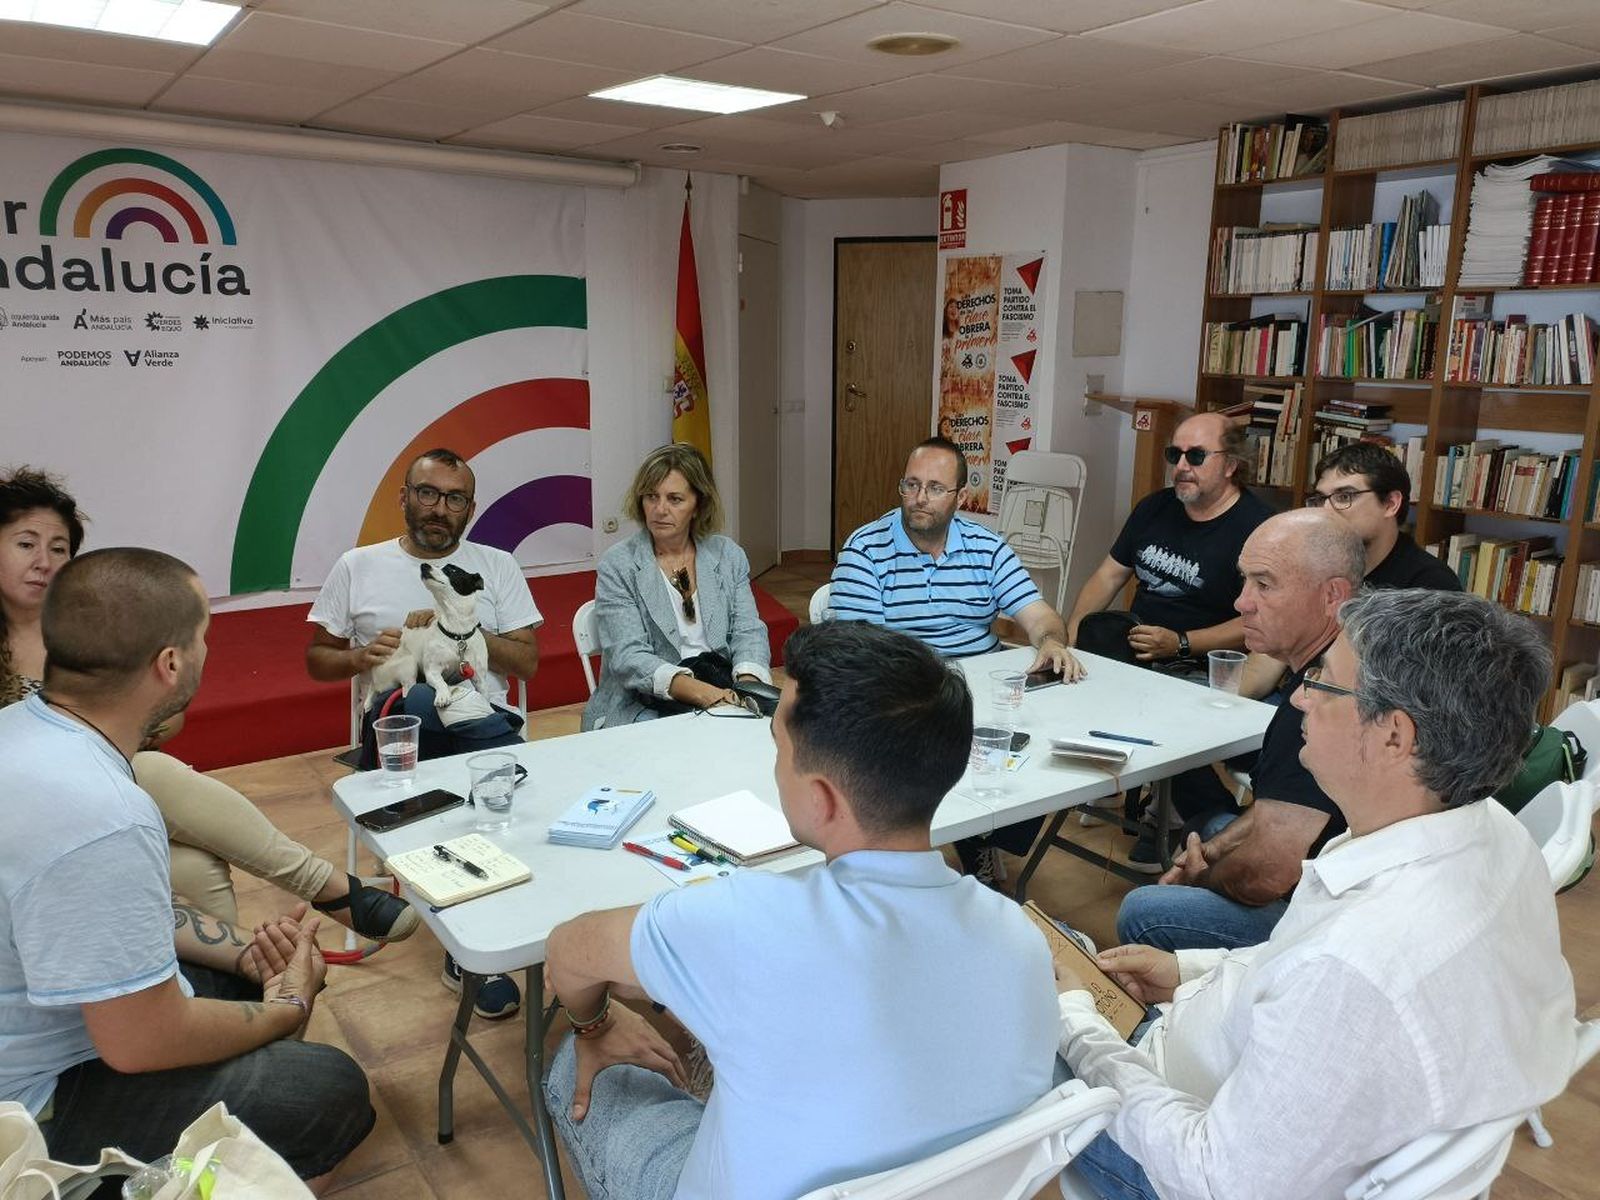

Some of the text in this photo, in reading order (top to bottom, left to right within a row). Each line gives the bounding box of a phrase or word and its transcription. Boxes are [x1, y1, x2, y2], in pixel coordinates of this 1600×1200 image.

[957, 294, 996, 310] DERECHOS
[1003, 295, 1030, 303] PARTIDO
[1002, 304, 1036, 312] CONTRA EL
[1002, 313, 1034, 321] FASCISMO
[959, 321, 991, 335] OBRERA
[57, 350, 112, 359] PODEMOS
[144, 349, 179, 359] Alianza
[144, 359, 173, 367] Verde
[998, 383, 1024, 391] PARTIDO
[997, 391, 1023, 400] CONTRA
[997, 400, 1029, 409] FASCISMO
[950, 416, 989, 428] DERECHOS
